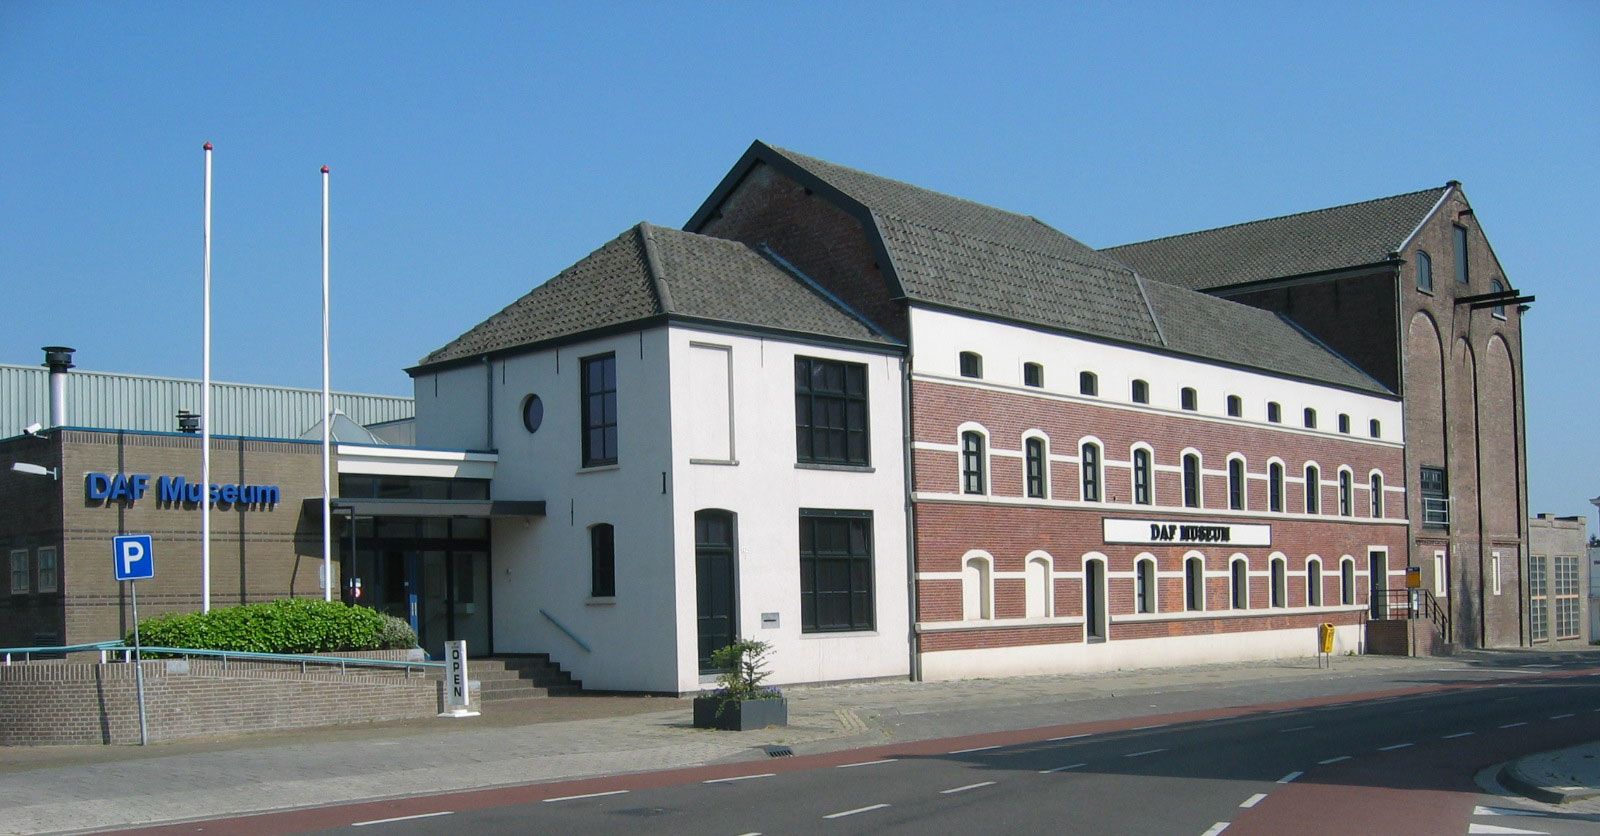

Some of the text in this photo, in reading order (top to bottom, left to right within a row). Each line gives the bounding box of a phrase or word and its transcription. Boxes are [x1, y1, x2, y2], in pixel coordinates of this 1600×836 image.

[87, 472, 281, 504] DAF Museum
[1150, 523, 1231, 542] DAF MUSEUM
[123, 541, 144, 574] P
[452, 650, 461, 696] OPEN
